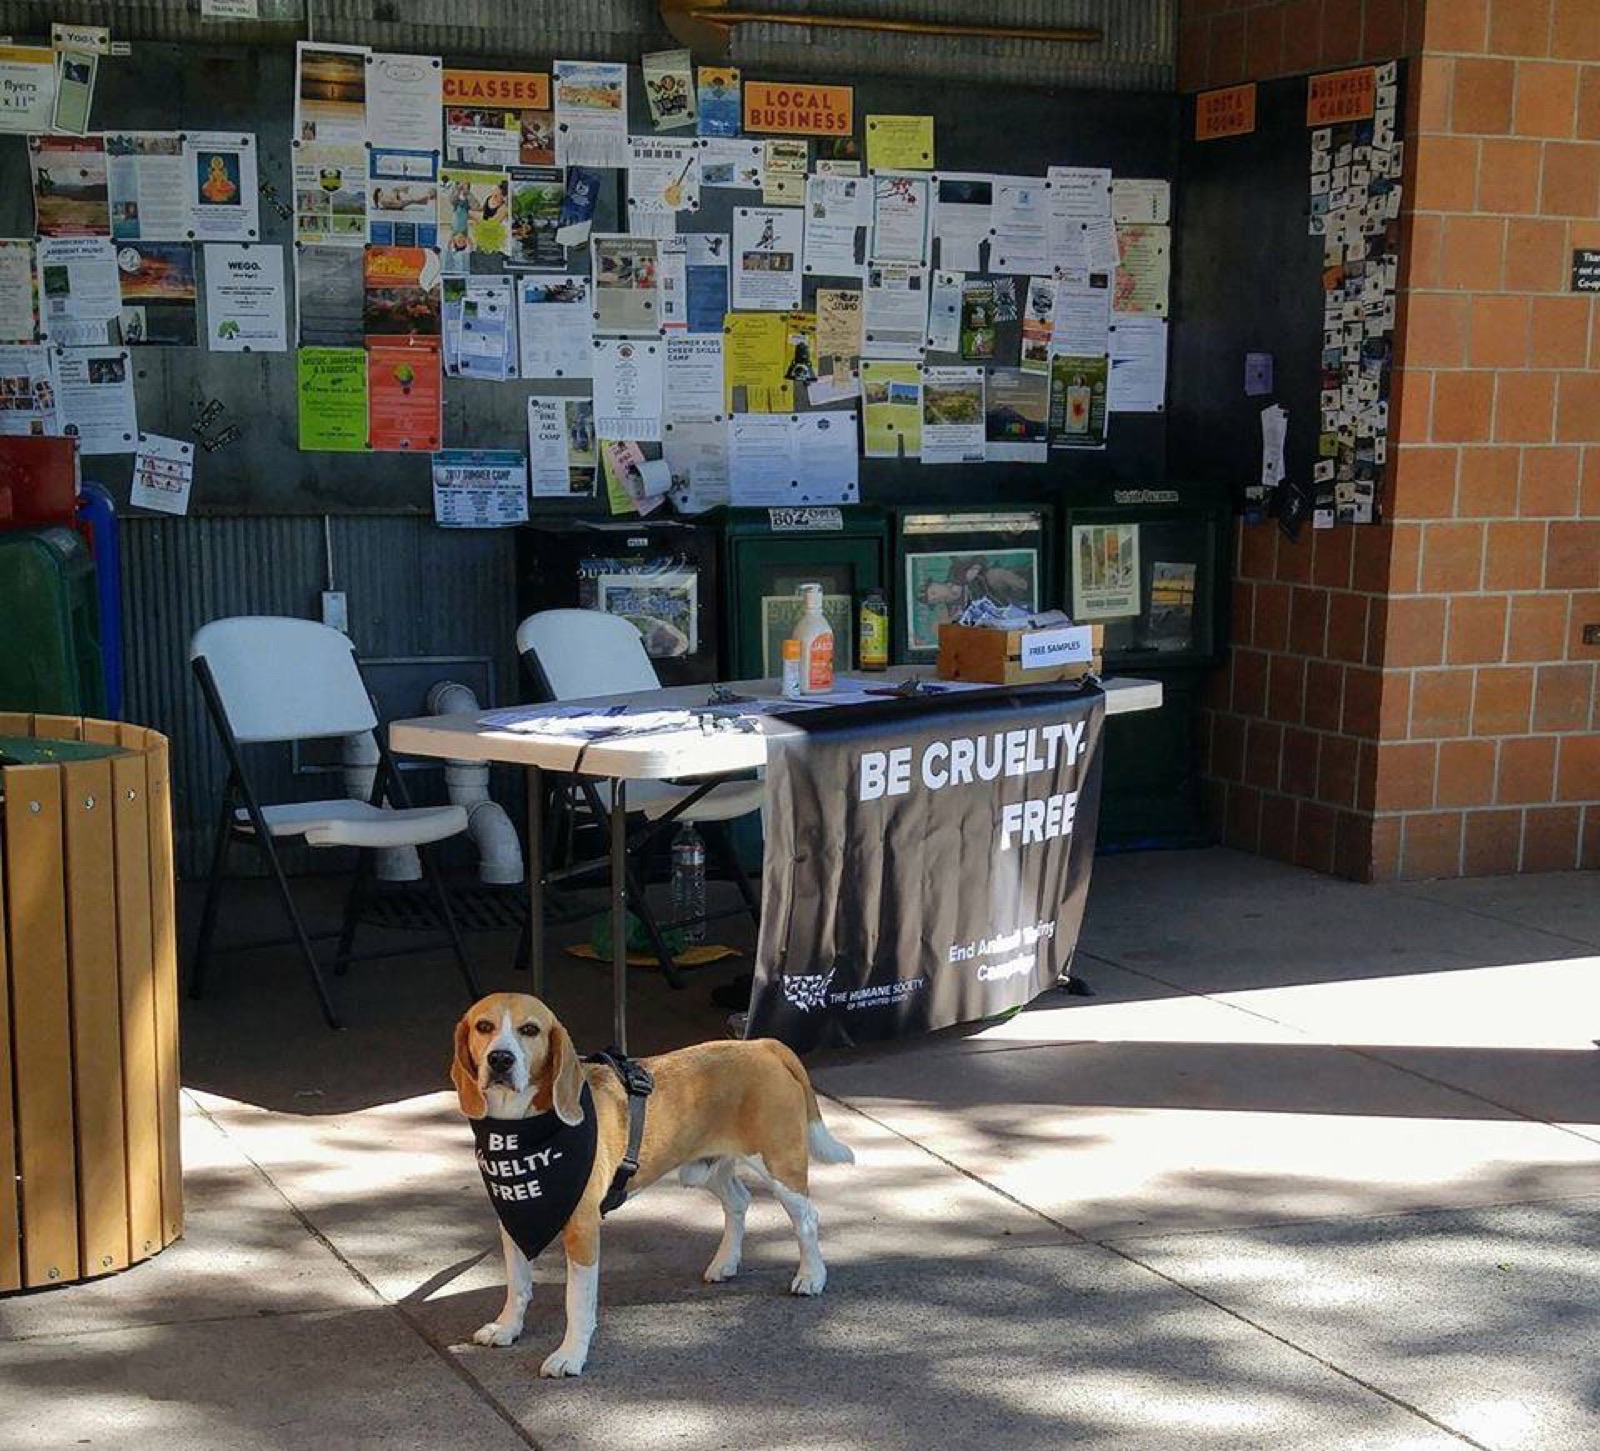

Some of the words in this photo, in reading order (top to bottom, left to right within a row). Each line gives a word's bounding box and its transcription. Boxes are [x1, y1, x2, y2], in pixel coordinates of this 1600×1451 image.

[4, 79, 37, 92] flyers
[442, 79, 538, 99] CLASSES
[1311, 75, 1371, 100] BUSINESS
[766, 90, 833, 109] LOCAL
[750, 109, 847, 131] BUSINESS
[1029, 645, 1046, 656] FREE
[1047, 641, 1081, 654] SAMPLES
[860, 748, 912, 801] BE
[1001, 791, 1078, 850] FREE
[949, 940, 976, 963] End
[830, 992, 848, 1004] THE
[849, 985, 893, 1001] HUMANE
[893, 977, 925, 994] SOCIETY
[489, 1133, 519, 1151] BE
[491, 1179, 543, 1202] FREE
